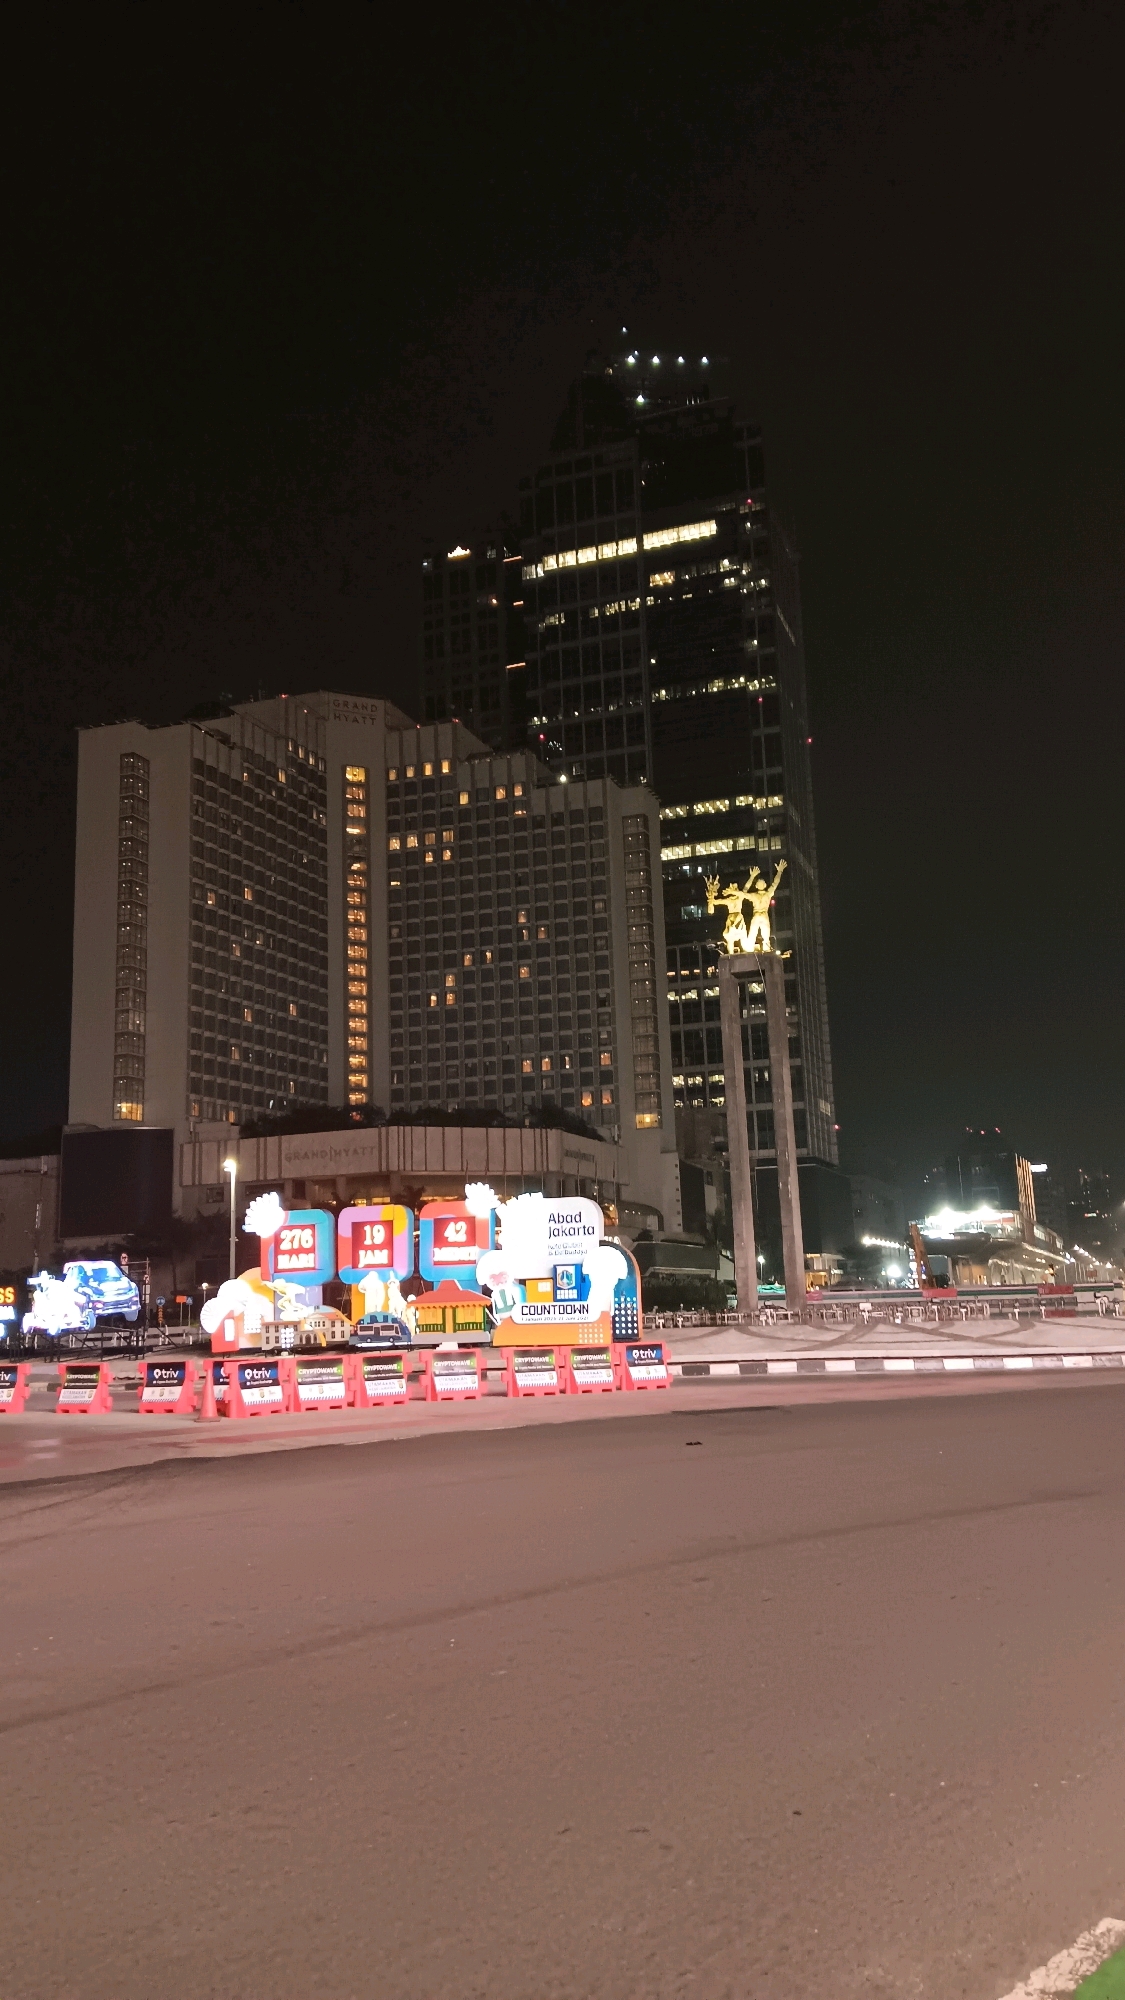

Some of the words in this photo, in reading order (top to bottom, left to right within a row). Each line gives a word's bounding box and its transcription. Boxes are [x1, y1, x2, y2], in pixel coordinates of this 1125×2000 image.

[333, 699, 377, 712] GRAND
[333, 712, 376, 725] HYATT
[284, 1150, 328, 1163] GRAND
[334, 1146, 376, 1157] HYATT
[548, 1211, 582, 1224] Abad
[363, 1224, 386, 1245] 19
[444, 1221, 467, 1243] 42
[548, 1225, 595, 1239] Jakarta
[279, 1228, 314, 1251] 276
[521, 1304, 589, 1315] COUNTDOWN
[639, 1348, 657, 1359] triv
[161, 1368, 179, 1378] triv
[252, 1367, 271, 1379] triv
[298, 1367, 338, 1375] CRYPTOWAVE
